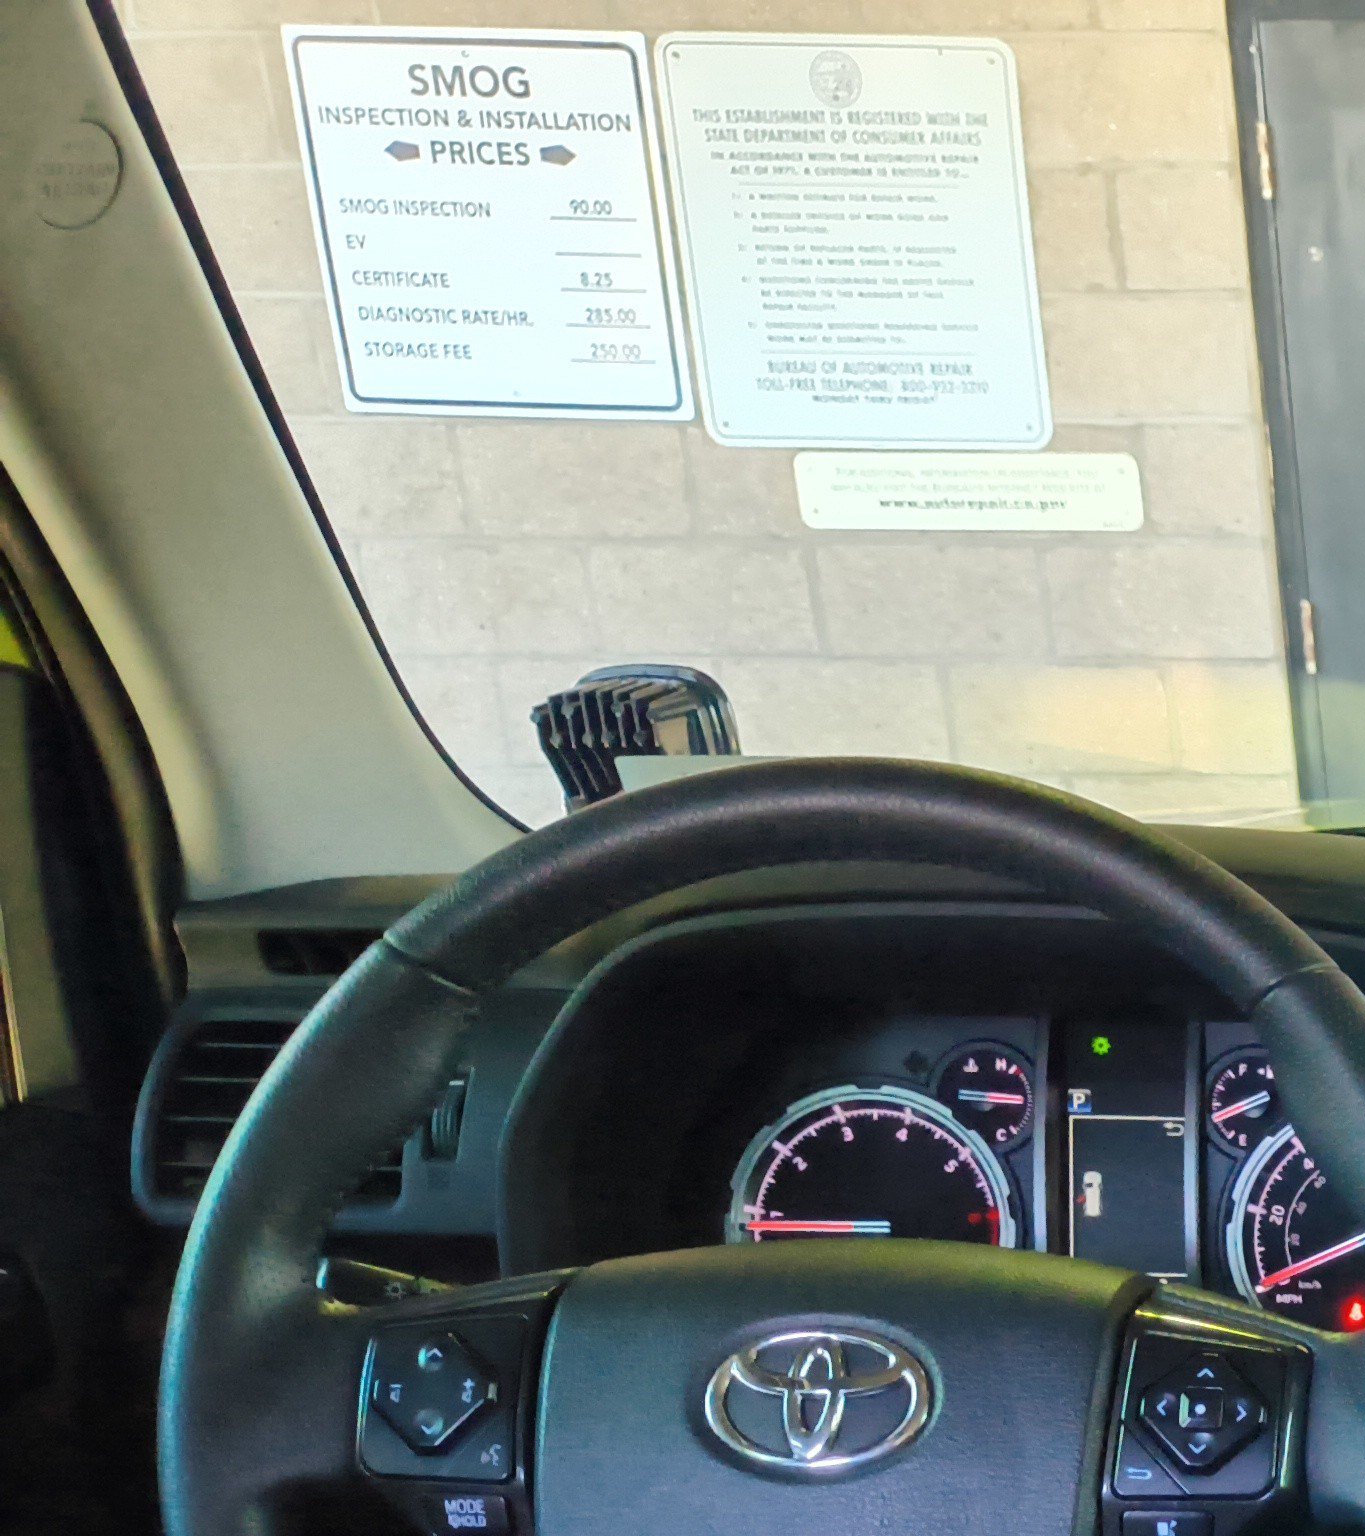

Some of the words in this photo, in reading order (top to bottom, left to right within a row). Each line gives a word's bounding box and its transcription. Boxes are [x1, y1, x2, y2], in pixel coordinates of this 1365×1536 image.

[408, 64, 531, 98] SMOG
[318, 105, 449, 127] INSPECTION
[457, 110, 473, 128] &
[480, 110, 631, 132] INSTALLATION
[430, 141, 530, 166] PRICES
[339, 199, 389, 215] SMOG
[394, 200, 491, 218] INSPECTION
[569, 200, 613, 216] 90.00
[346, 234, 366, 250] EV
[352, 270, 451, 289] CERTIFICATE
[580, 272, 613, 287] 8.25
[357, 306, 457, 324] DIAGNOSTIC
[364, 341, 439, 360] STORAGE
[444, 344, 473, 360] FEE
[1072, 1092, 1087, 1110] P
[841, 1125, 855, 1143] 3
[895, 1127, 909, 1143] 4
[995, 1128, 1008, 1142] C
[791, 1156, 809, 1173] 2
[943, 1158, 960, 1174] 5
[444, 1498, 486, 1514] MODE
